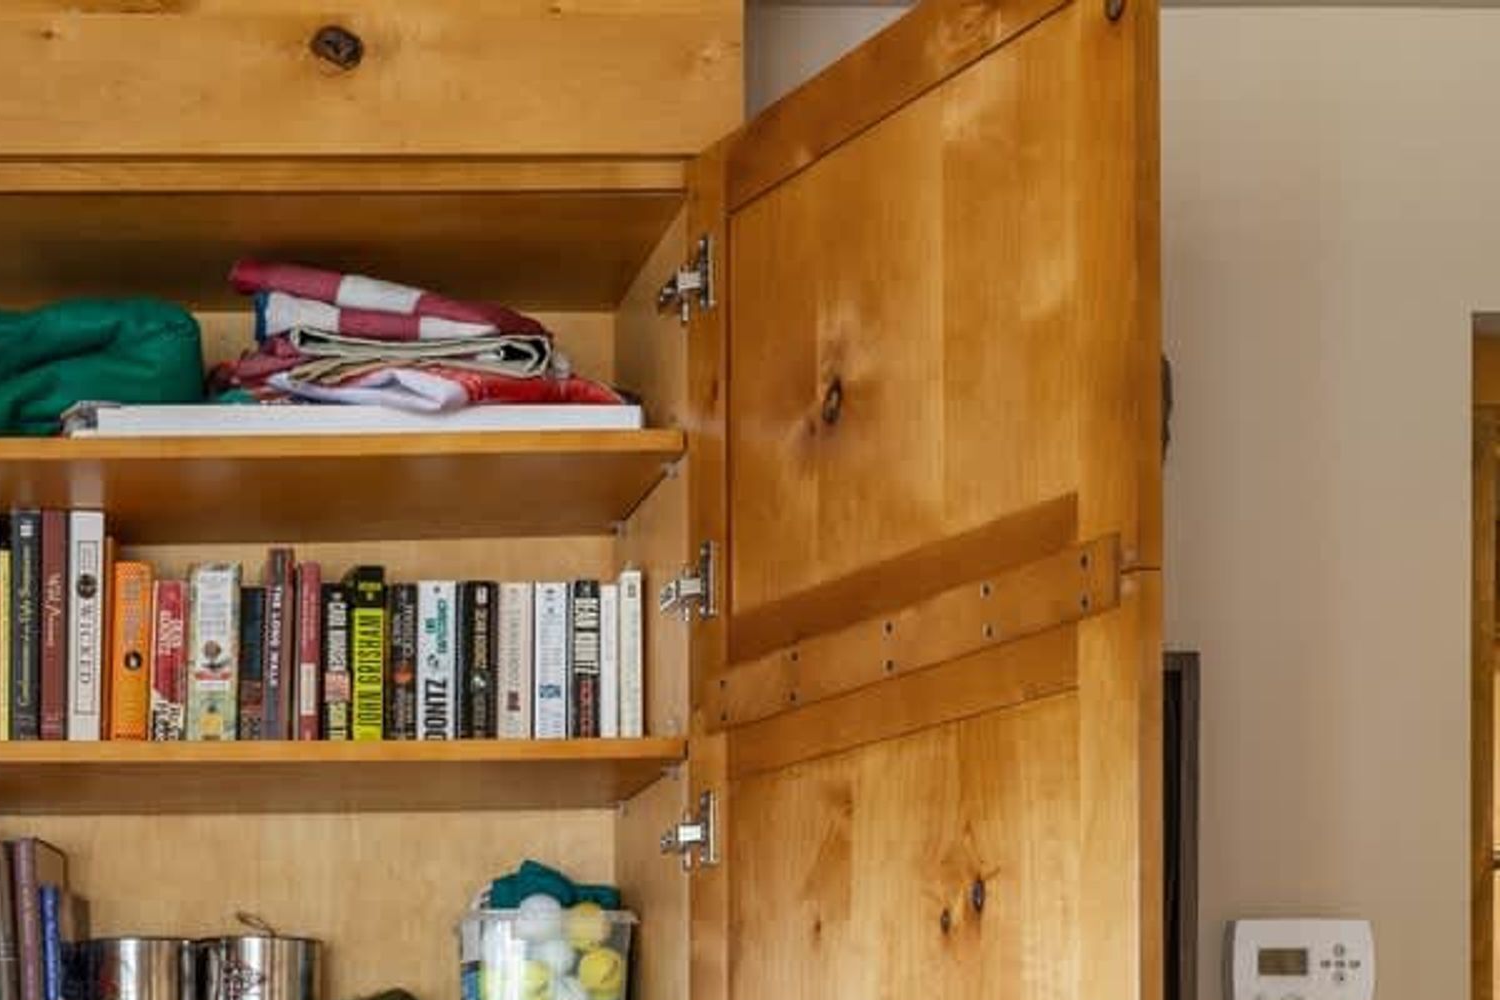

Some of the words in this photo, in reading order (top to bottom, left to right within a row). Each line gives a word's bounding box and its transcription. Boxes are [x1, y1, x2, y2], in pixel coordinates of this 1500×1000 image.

[272, 585, 282, 609] THE
[79, 604, 93, 684] WICKED
[270, 612, 281, 647] LONG
[358, 615, 381, 684] GRISHAM
[269, 651, 281, 687] WALK
[358, 690, 381, 726] JOHN
